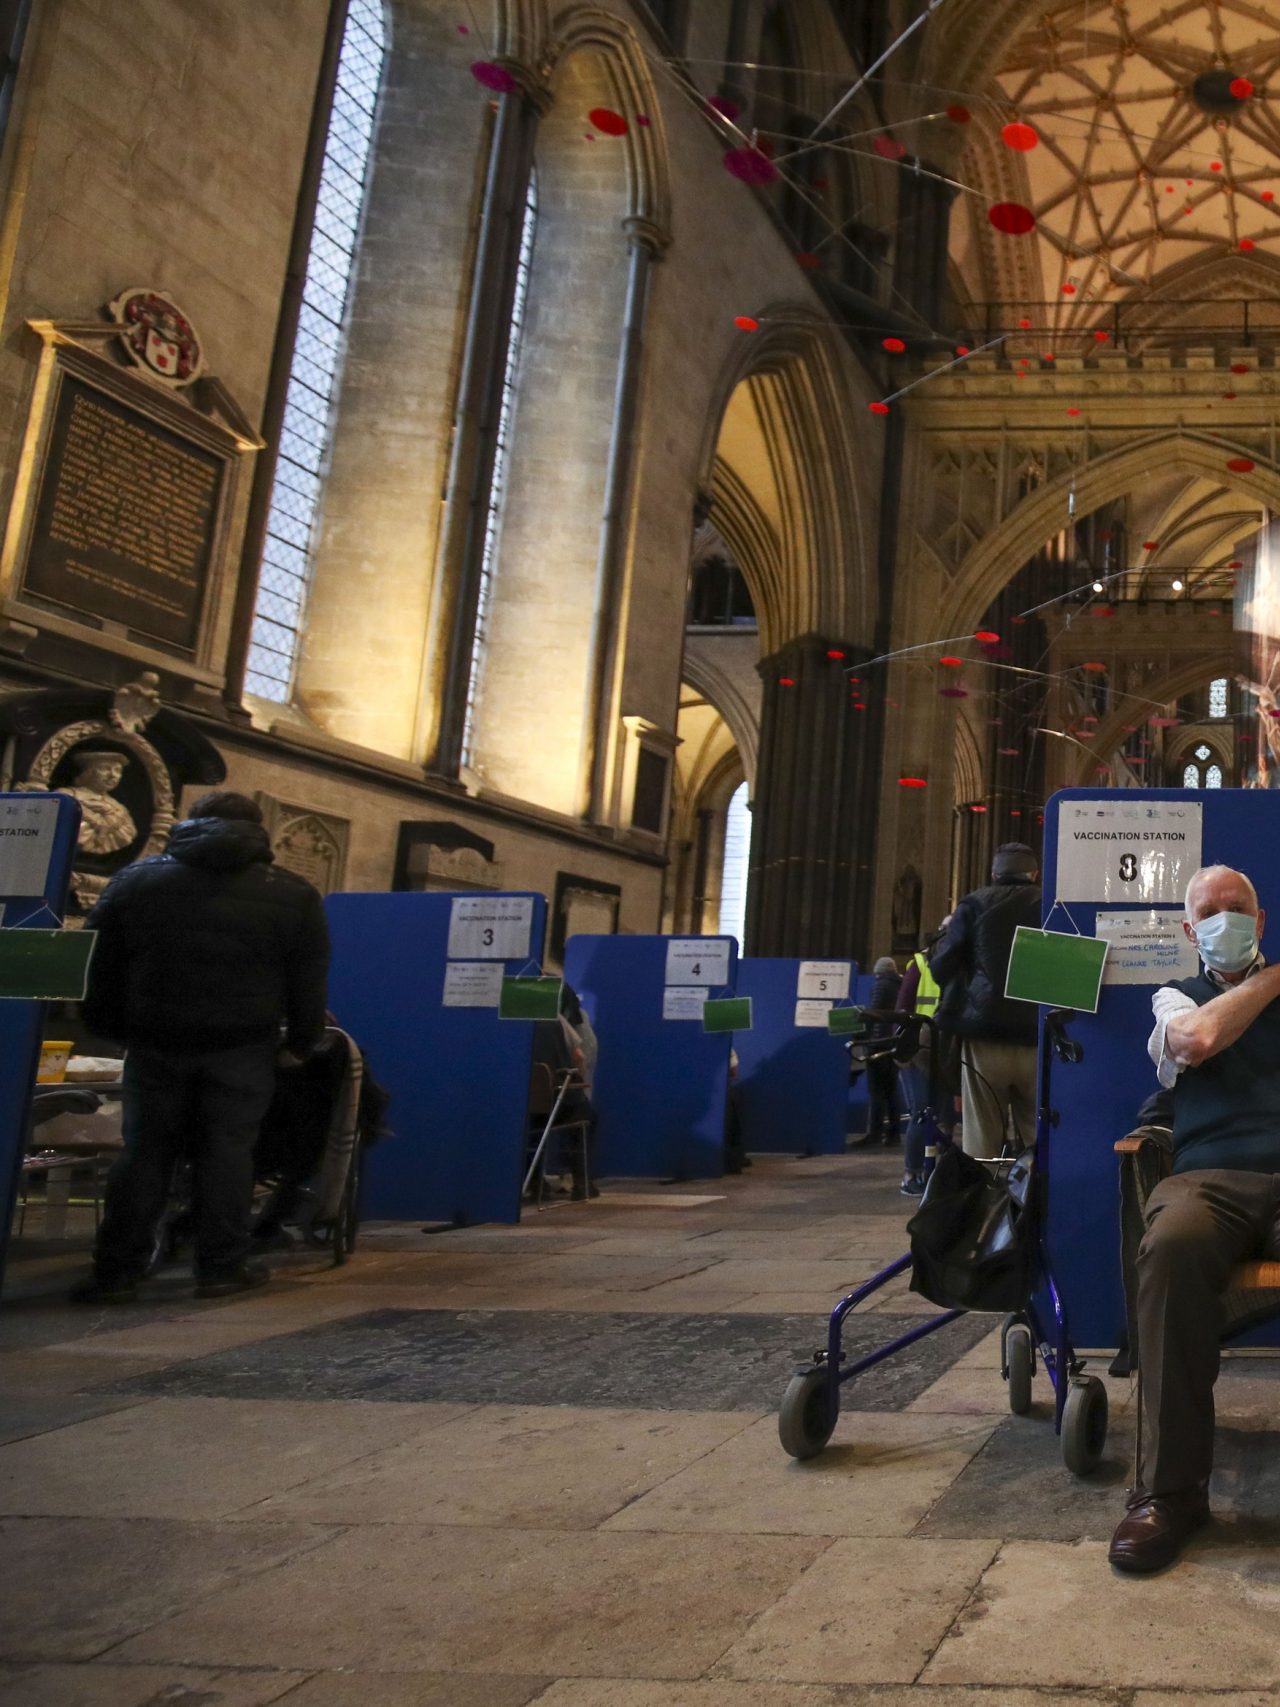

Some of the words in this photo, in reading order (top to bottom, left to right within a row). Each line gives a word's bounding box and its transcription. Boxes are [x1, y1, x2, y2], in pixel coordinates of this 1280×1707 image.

[1073, 832, 1140, 840] VACCINATION
[1143, 832, 1185, 840] STATION
[1118, 853, 1137, 881] 8
[482, 928, 494, 946] 3
[691, 963, 701, 976] 4
[819, 980, 827, 991] 5
